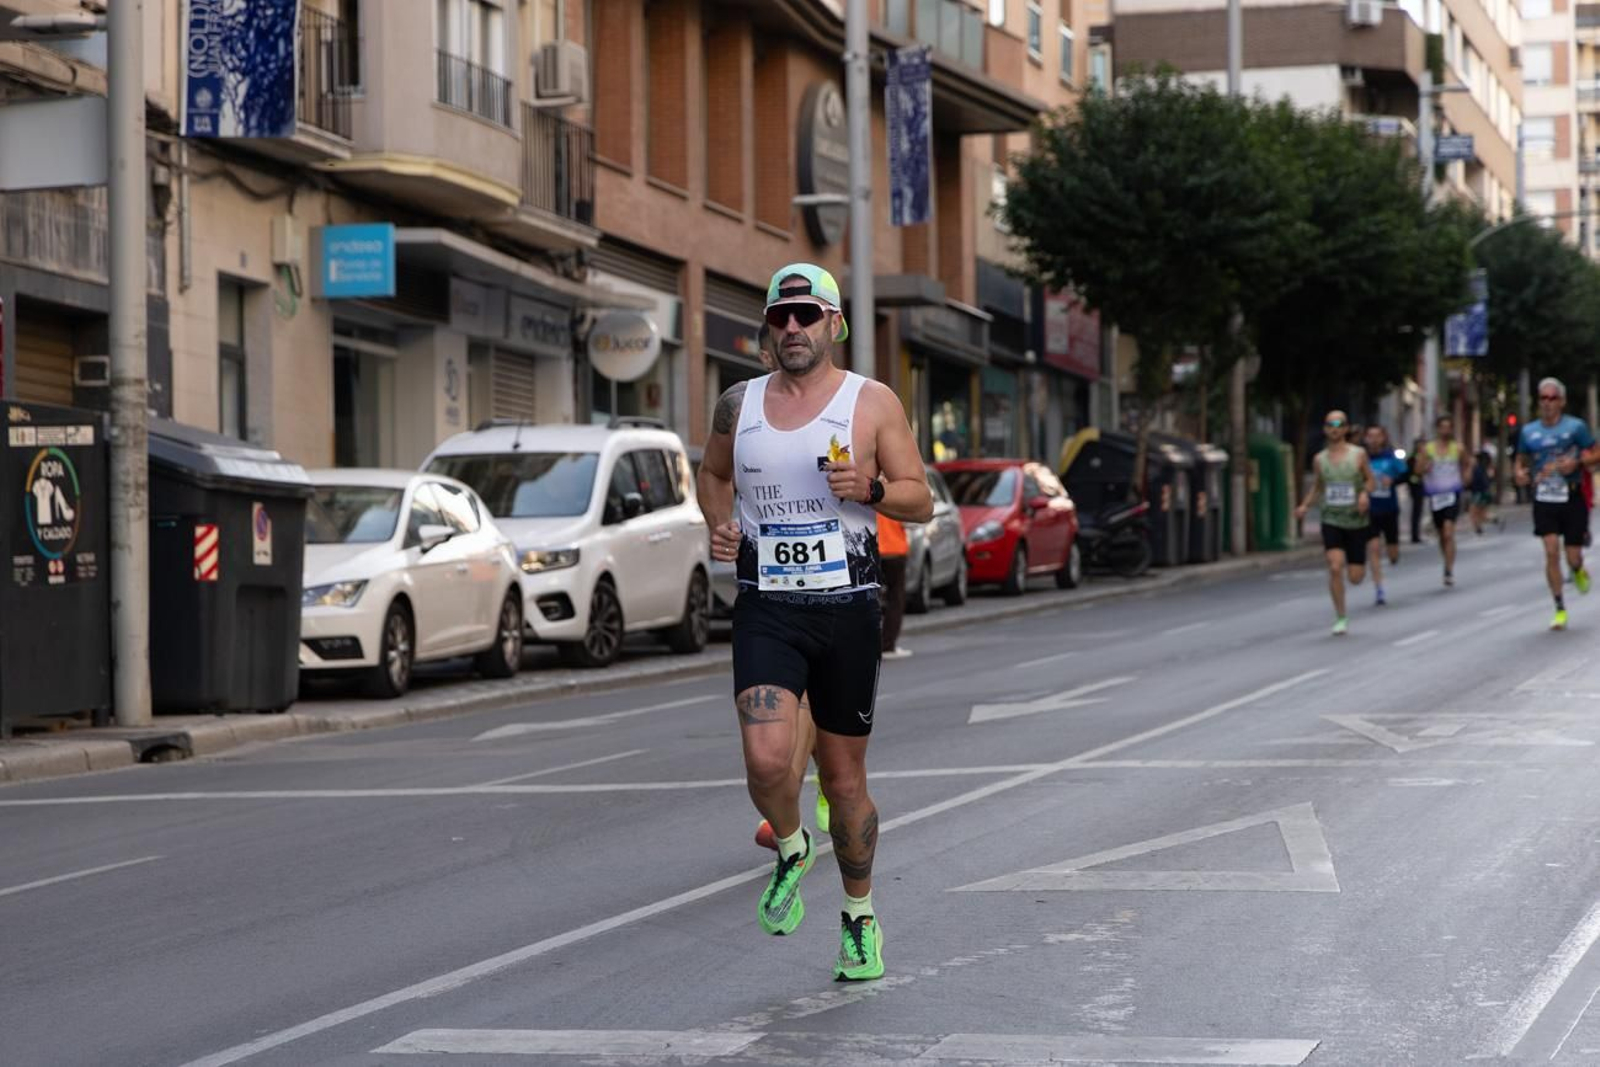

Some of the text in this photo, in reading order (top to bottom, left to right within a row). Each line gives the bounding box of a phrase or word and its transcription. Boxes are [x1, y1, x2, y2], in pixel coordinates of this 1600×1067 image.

[208, 35, 221, 75] JUAN
[40, 461, 65, 478] ROPA
[752, 484, 783, 501] THE
[756, 498, 826, 519] MYSTERY
[774, 539, 827, 565] 681
